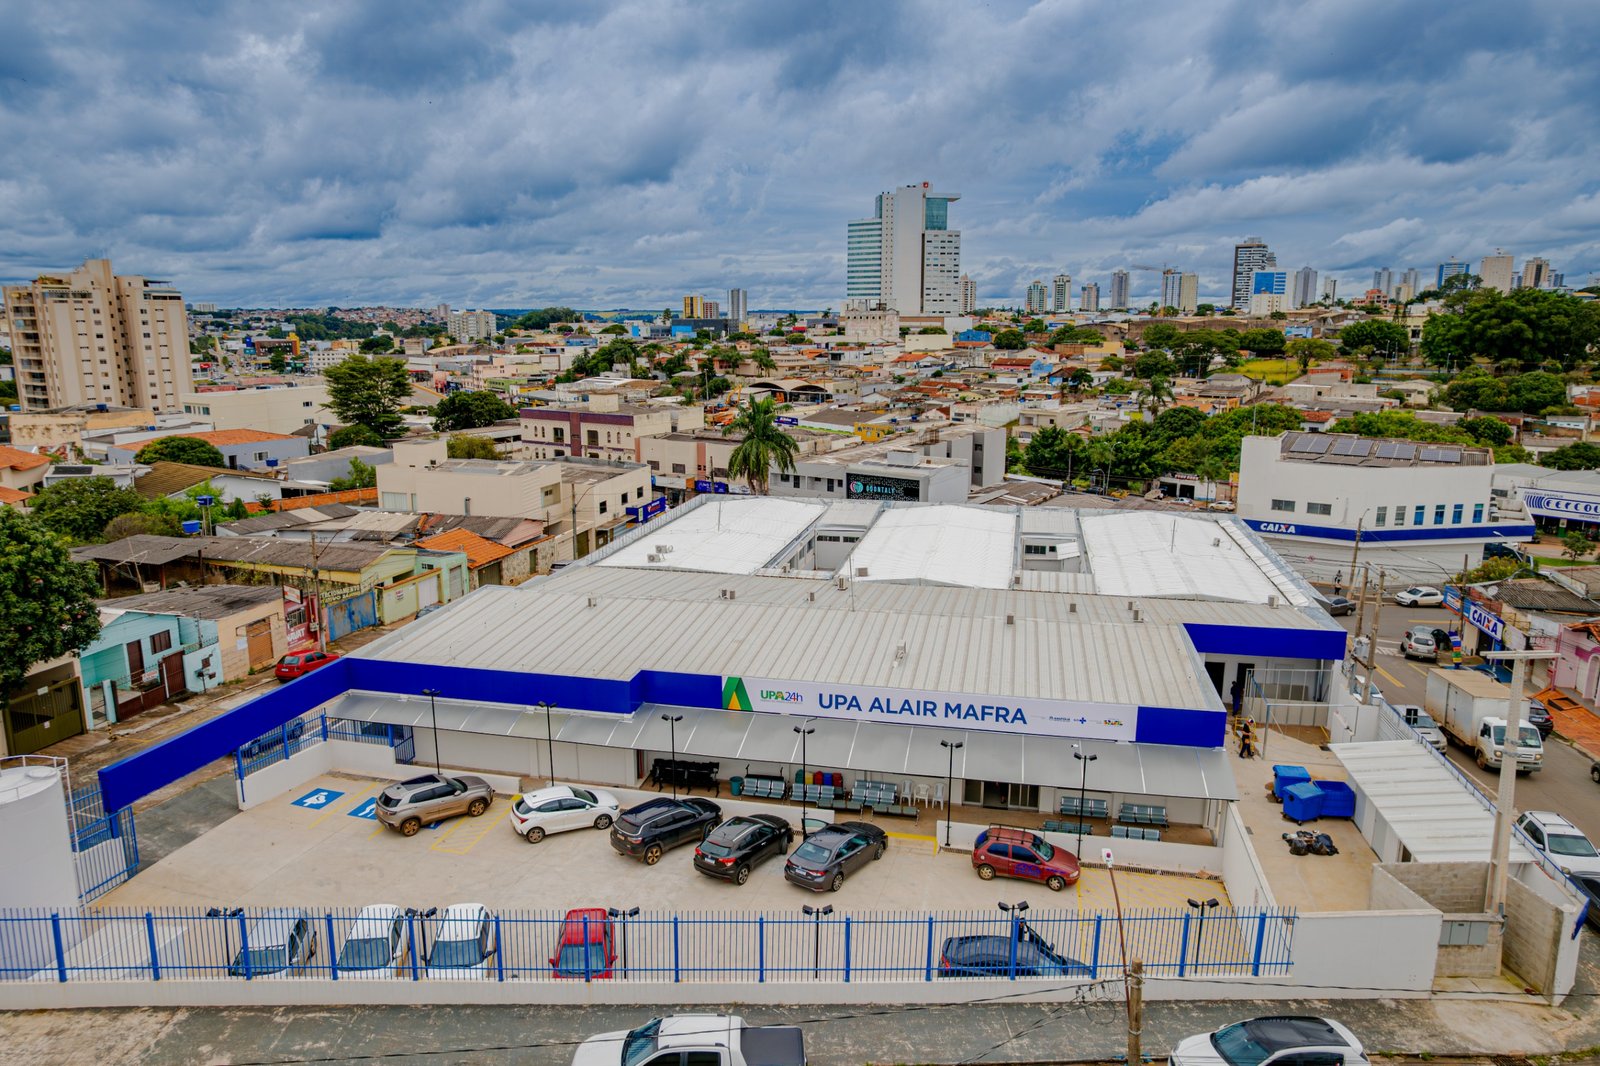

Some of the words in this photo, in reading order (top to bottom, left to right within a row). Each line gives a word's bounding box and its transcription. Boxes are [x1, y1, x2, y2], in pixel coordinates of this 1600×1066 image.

[1260, 523, 1296, 534] CAIXA
[1472, 609, 1498, 635] CAIXA
[818, 693, 862, 712] UPA
[869, 697, 937, 717] ALAIR
[944, 702, 1028, 725] MAFRA
